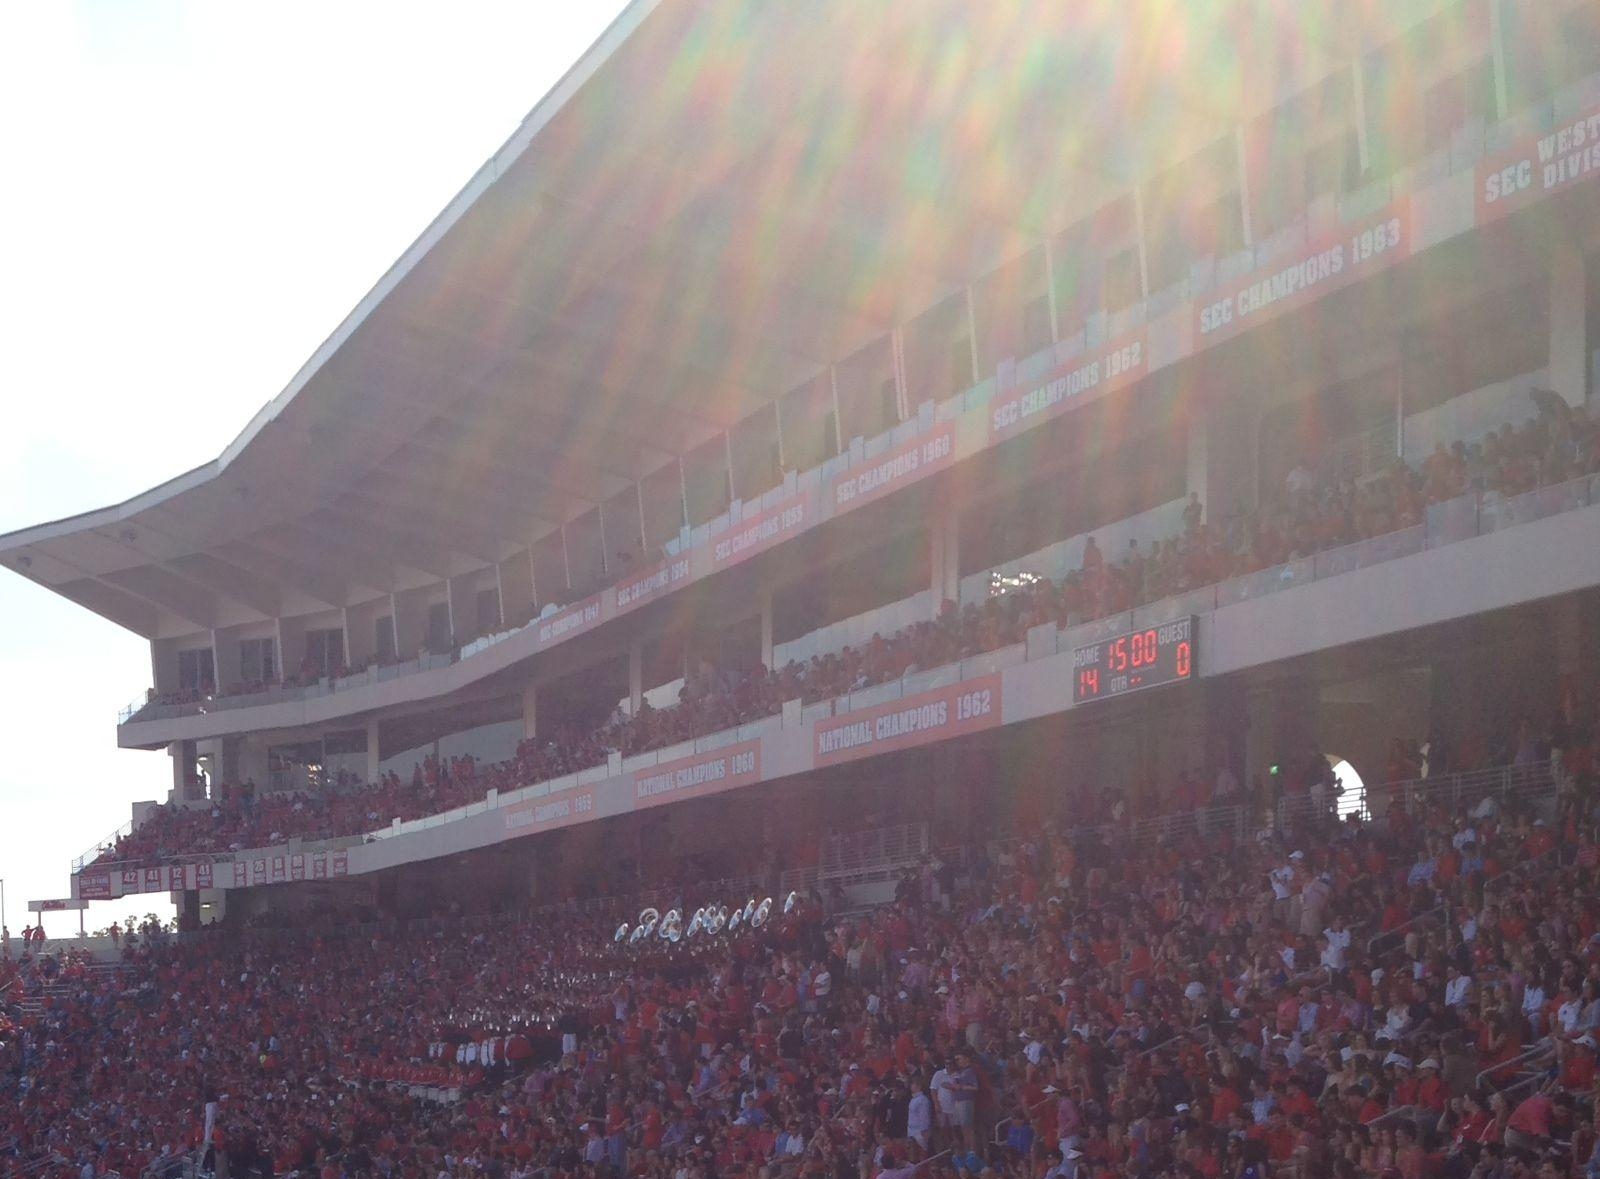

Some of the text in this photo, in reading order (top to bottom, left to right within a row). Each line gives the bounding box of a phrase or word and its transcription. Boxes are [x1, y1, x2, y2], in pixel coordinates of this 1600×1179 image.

[1485, 159, 1531, 203] SEC
[1200, 217, 1400, 334] SEC CHAMPIONS 1963
[993, 341, 1142, 431] SEC CHAMPIONS 1962
[837, 434, 950, 504] SEC CHAMPIONS 1960
[732, 516, 778, 551] CHAMPIONS
[1158, 622, 1190, 646] GUEST
[1073, 646, 1100, 668] HOME
[1176, 642, 1190, 677] 0
[1079, 669, 1098, 697] 14
[819, 691, 991, 754] NATIONAL CHAMPIONS 1962
[637, 772, 676, 799] NATIONAL
[677, 759, 726, 789] CHAMPIONS
